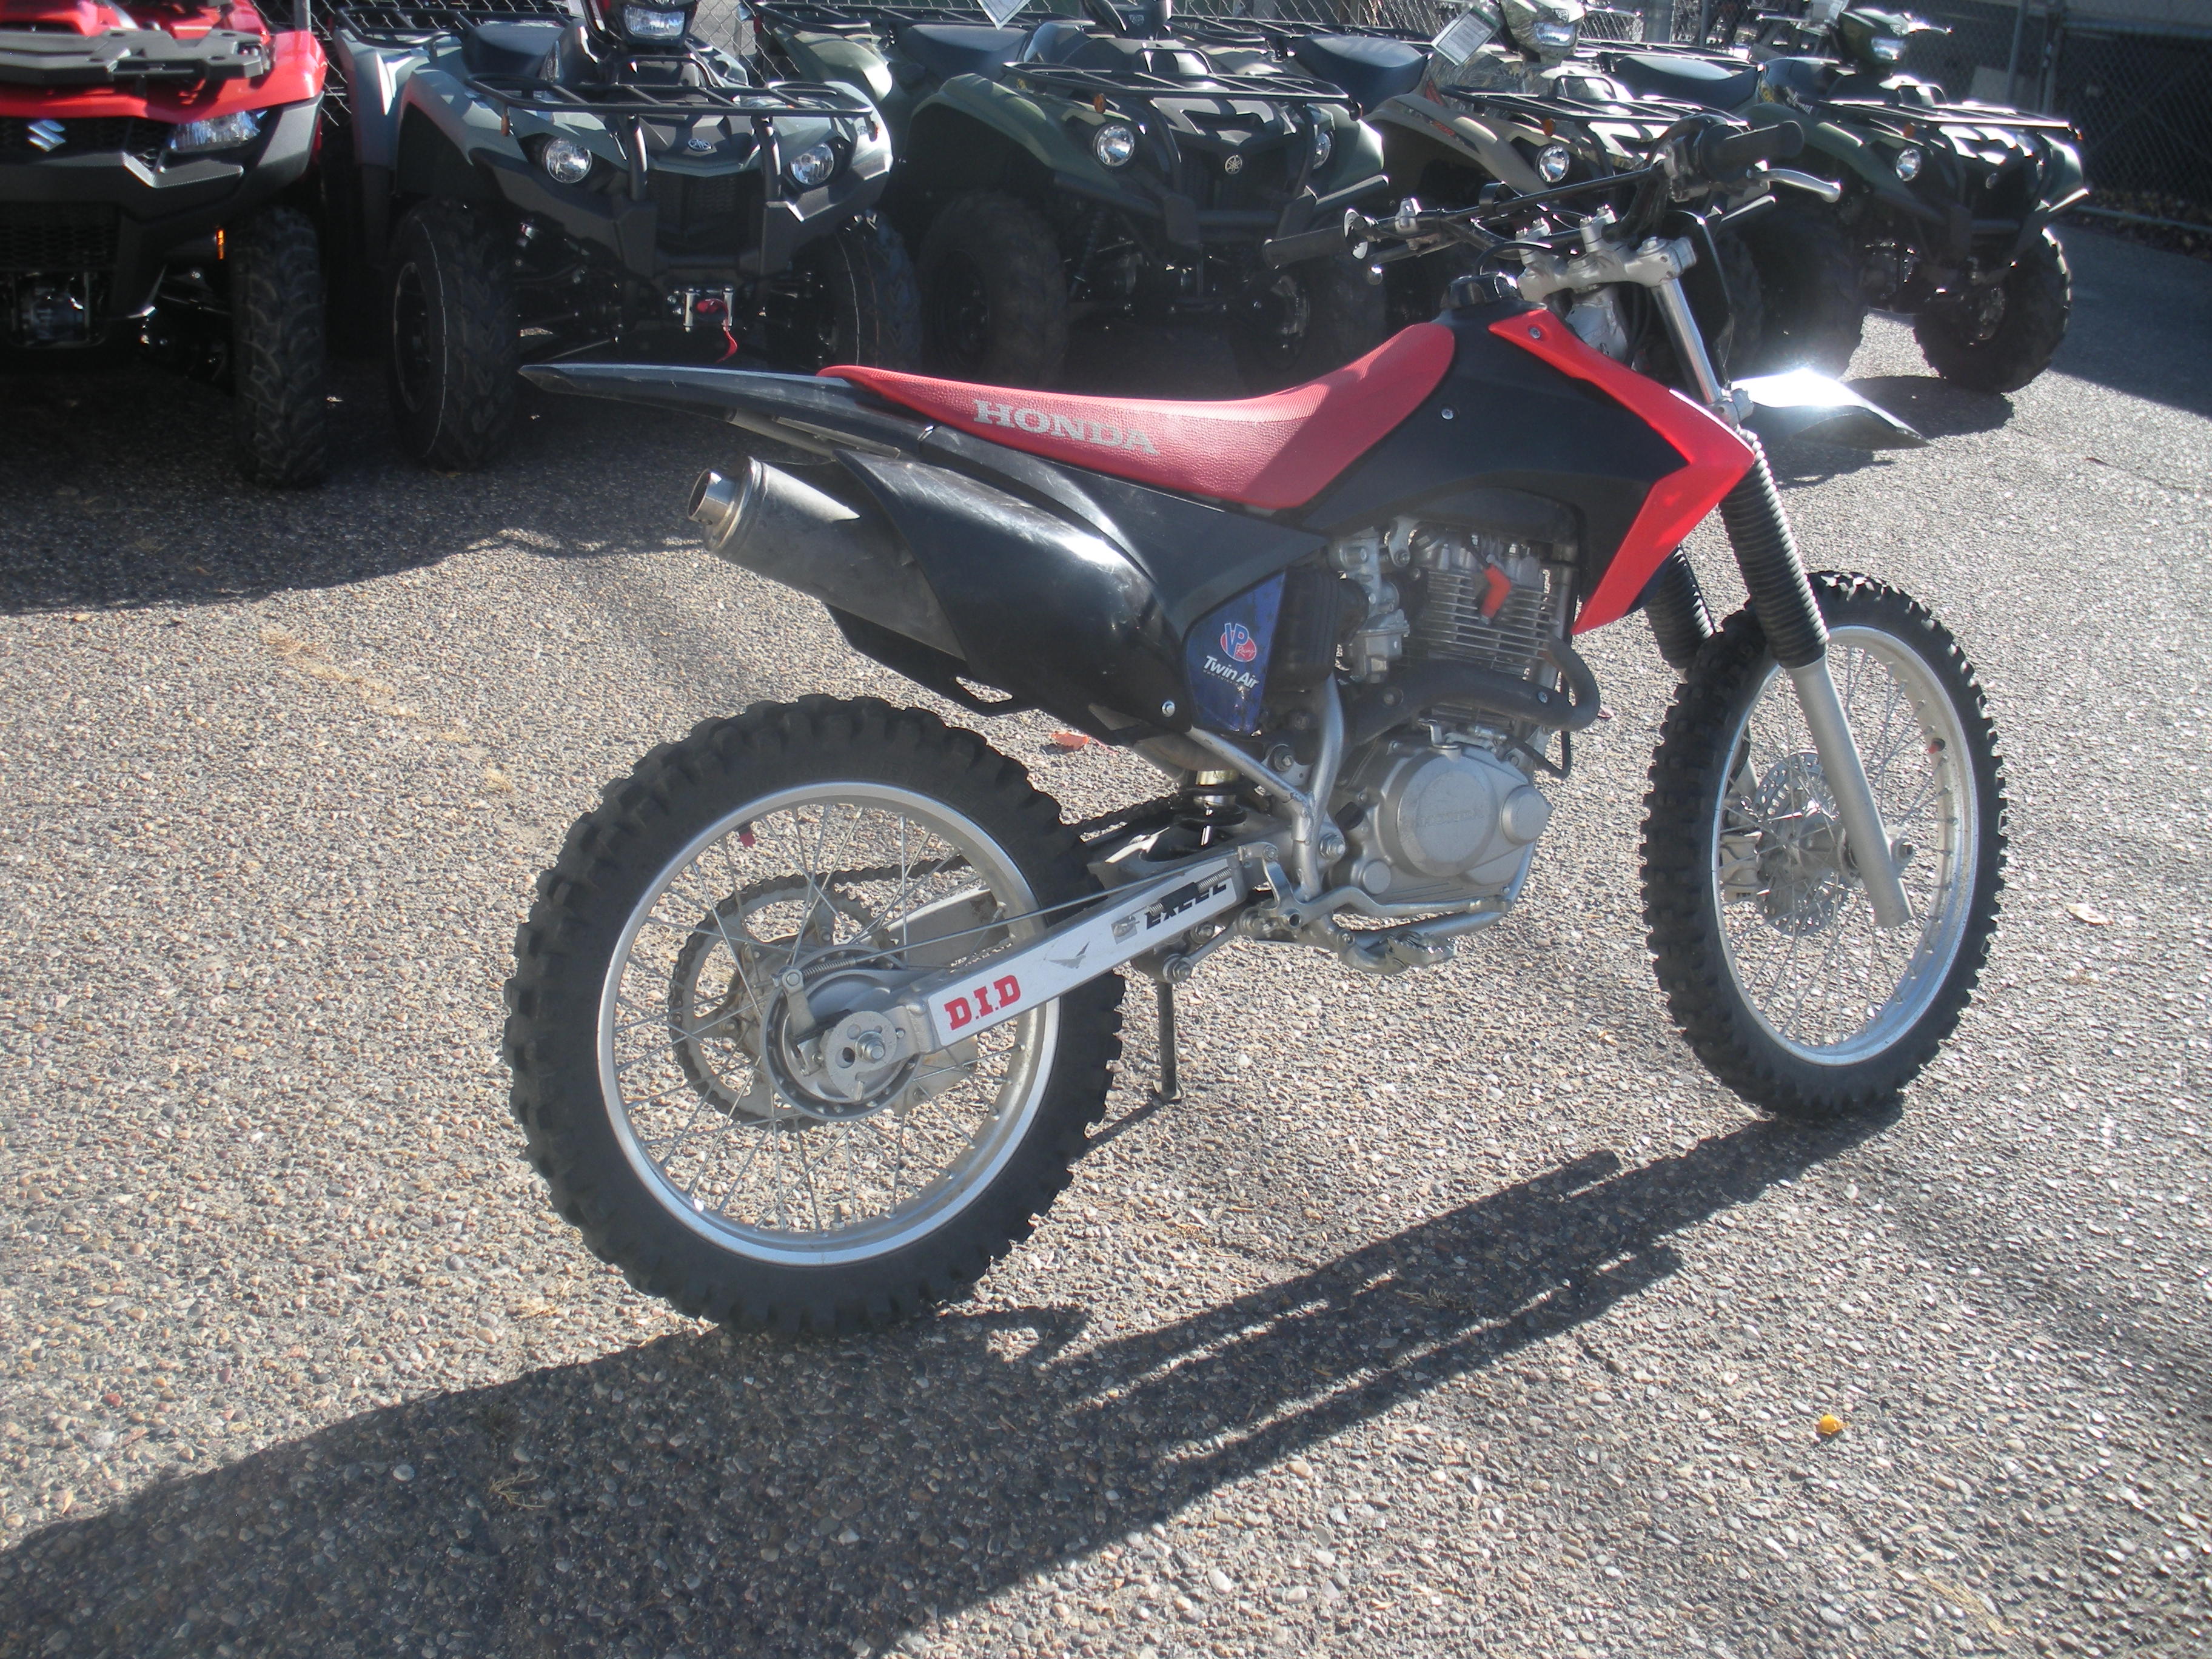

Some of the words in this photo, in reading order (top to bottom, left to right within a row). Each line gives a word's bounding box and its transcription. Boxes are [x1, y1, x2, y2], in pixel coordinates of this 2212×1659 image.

[973, 400, 1159, 455] HONDA
[1224, 622, 1250, 658] VP
[1204, 655, 1238, 680] Twin
[1236, 672, 1259, 688] Air
[944, 974, 1021, 1031] D.I.D
